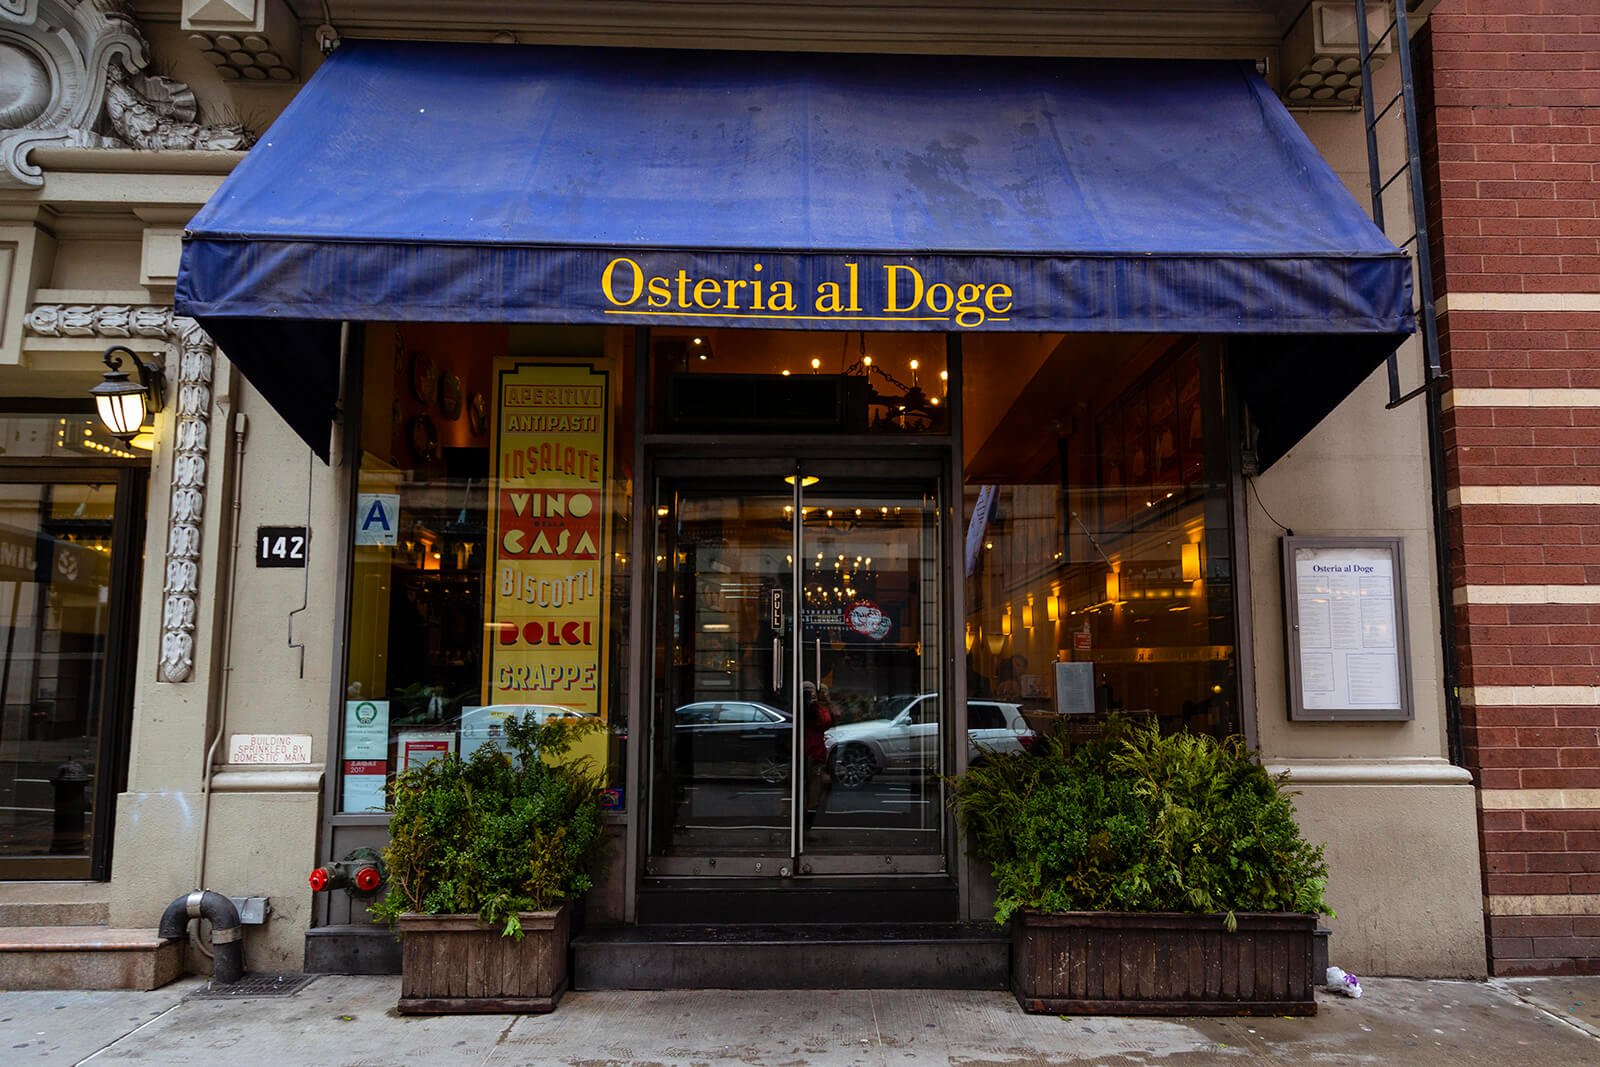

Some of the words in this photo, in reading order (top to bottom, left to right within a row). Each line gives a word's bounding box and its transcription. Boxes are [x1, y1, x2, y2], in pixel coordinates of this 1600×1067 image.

[601, 257, 798, 312] Osteria
[815, 263, 864, 313] al
[883, 264, 1013, 328] Doge
[508, 415, 596, 432] ANTIPASTI
[504, 442, 600, 482] INSALATE
[361, 499, 391, 531] A
[508, 493, 593, 518] VINO
[262, 536, 304, 559] 142
[503, 529, 597, 555] CASA
[1312, 564, 1342, 573] Osteria
[1343, 565, 1352, 573] al
[1354, 564, 1374, 574] Doge
[501, 566, 595, 608] BISCOTTI
[773, 594, 781, 626] PULL
[499, 621, 593, 646] DOLCI
[496, 663, 597, 691] GRAPPE
[238, 745, 287, 754] SPRINKLED
[292, 745, 304, 754] BY
[250, 736, 291, 746] BUILDING
[233, 753, 278, 762] DOMESTIC
[284, 753, 306, 762] MAIN
